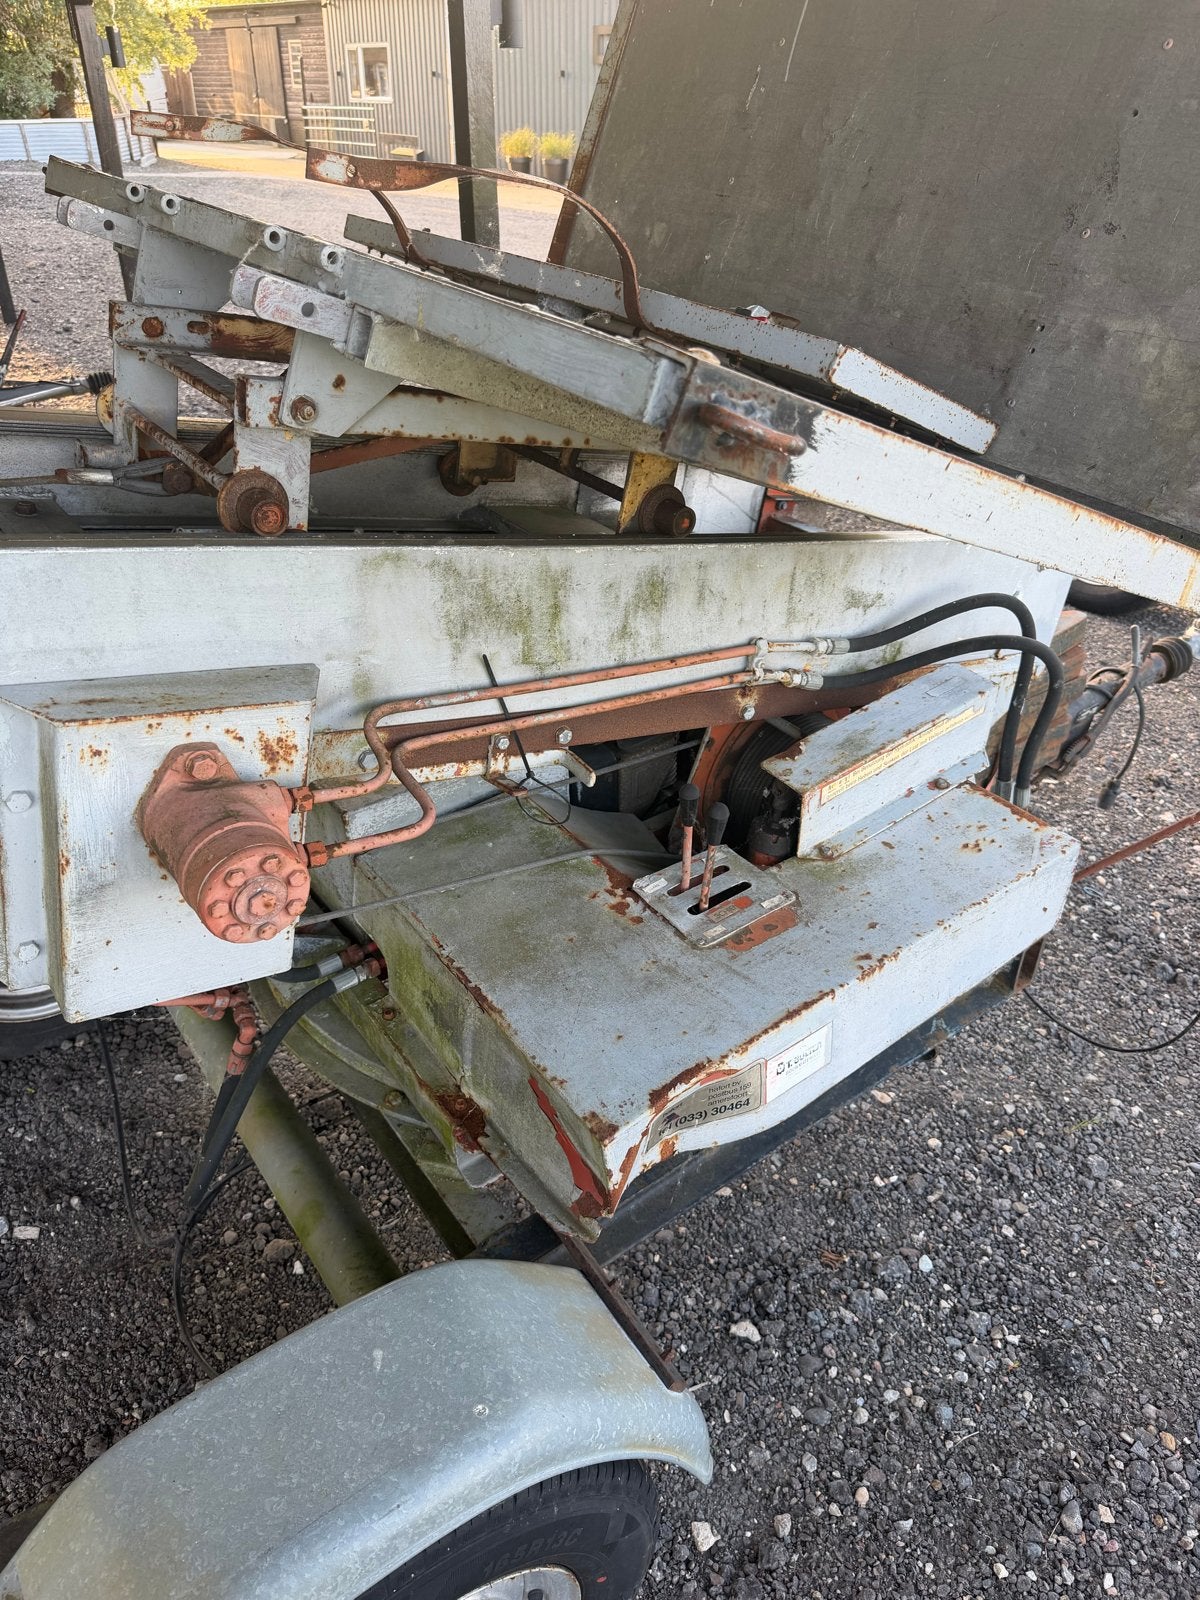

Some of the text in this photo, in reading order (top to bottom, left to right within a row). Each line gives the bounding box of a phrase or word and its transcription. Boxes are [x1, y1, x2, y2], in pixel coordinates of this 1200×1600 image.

[707, 1088, 738, 1101] postbus
[707, 1091, 748, 1107] amersfoort
[675, 1110, 708, 1127] (033)
[711, 1098, 750, 1116] 30464
